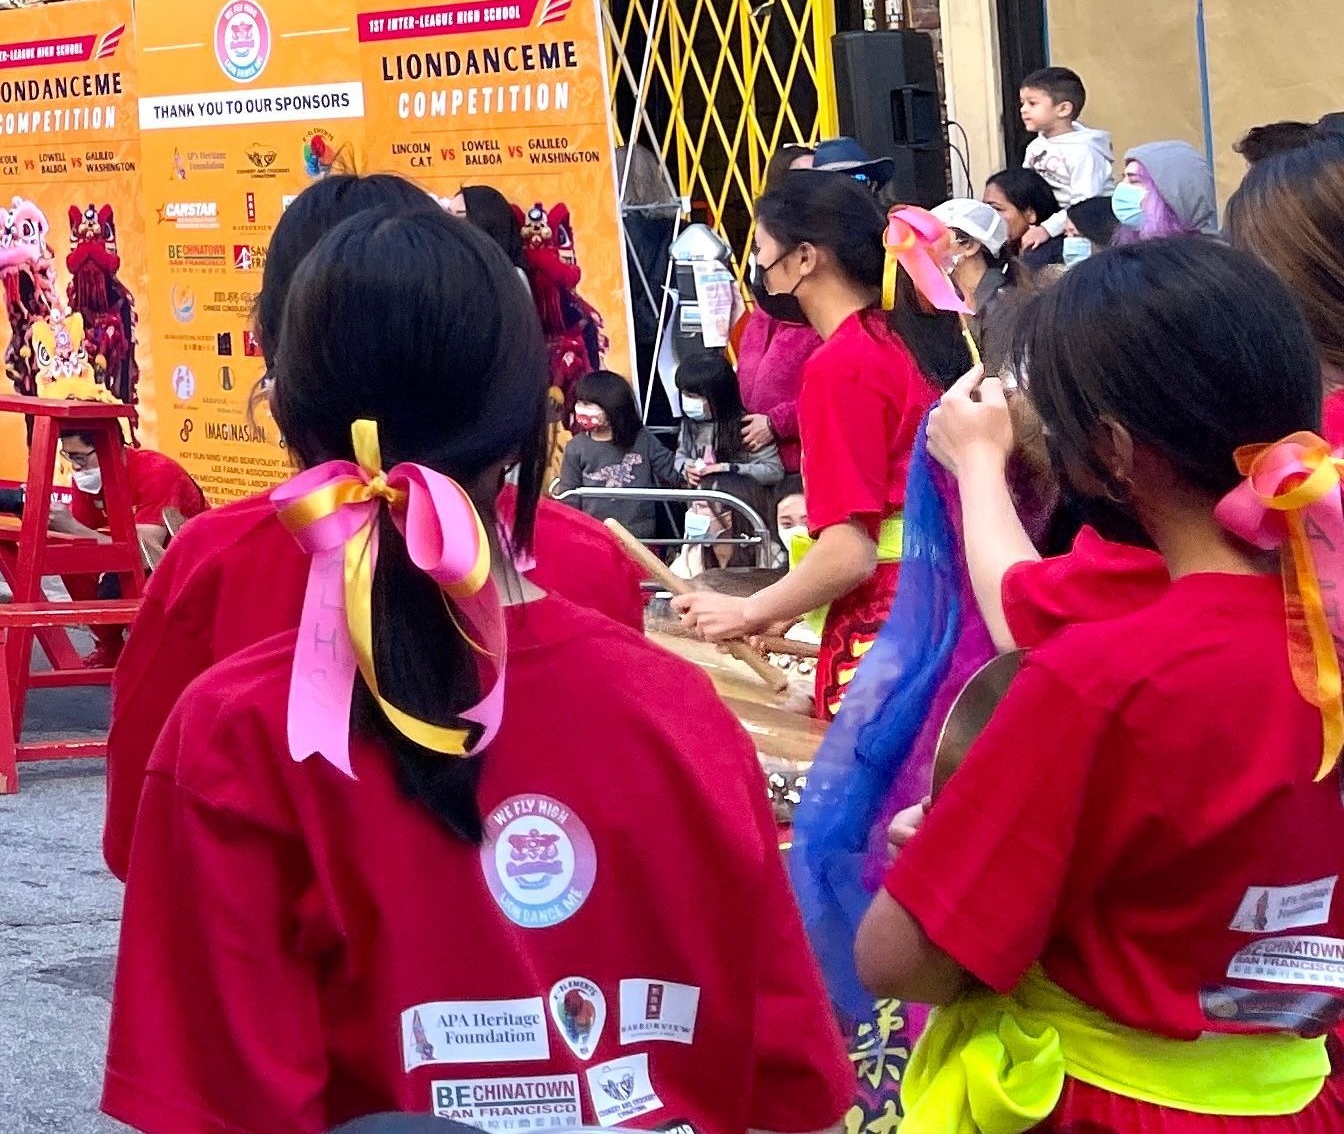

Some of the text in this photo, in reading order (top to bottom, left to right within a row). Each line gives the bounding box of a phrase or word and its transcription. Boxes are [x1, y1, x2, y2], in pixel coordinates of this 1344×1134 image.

[369, 19, 383, 33] 1ST
[387, 12, 454, 30] INTER-LEAGUE
[484, 5, 520, 22] SCHOOL
[382, 41, 578, 80] LIONDANCEME
[154, 92, 350, 119] THANK YOU TO OUR SPONSORS
[398, 82, 569, 118] COMPETITION
[392, 137, 568, 161] LINCOLN VS LOWELL VS GALILEO
[465, 153, 502, 165] BALBOA
[530, 150, 600, 164] WASHINGTON
[166, 202, 218, 217] CARSTAR
[493, 799, 569, 826] WE FLY HIGH
[436, 1012, 540, 1028] APA Heritage
[621, 1022, 691, 1034] HARBORVIEW
[445, 1030, 536, 1045] Foundation
[436, 1080, 575, 1109] BE CHINATOWN
[438, 1104, 577, 1119] SAN FRANCISCO
